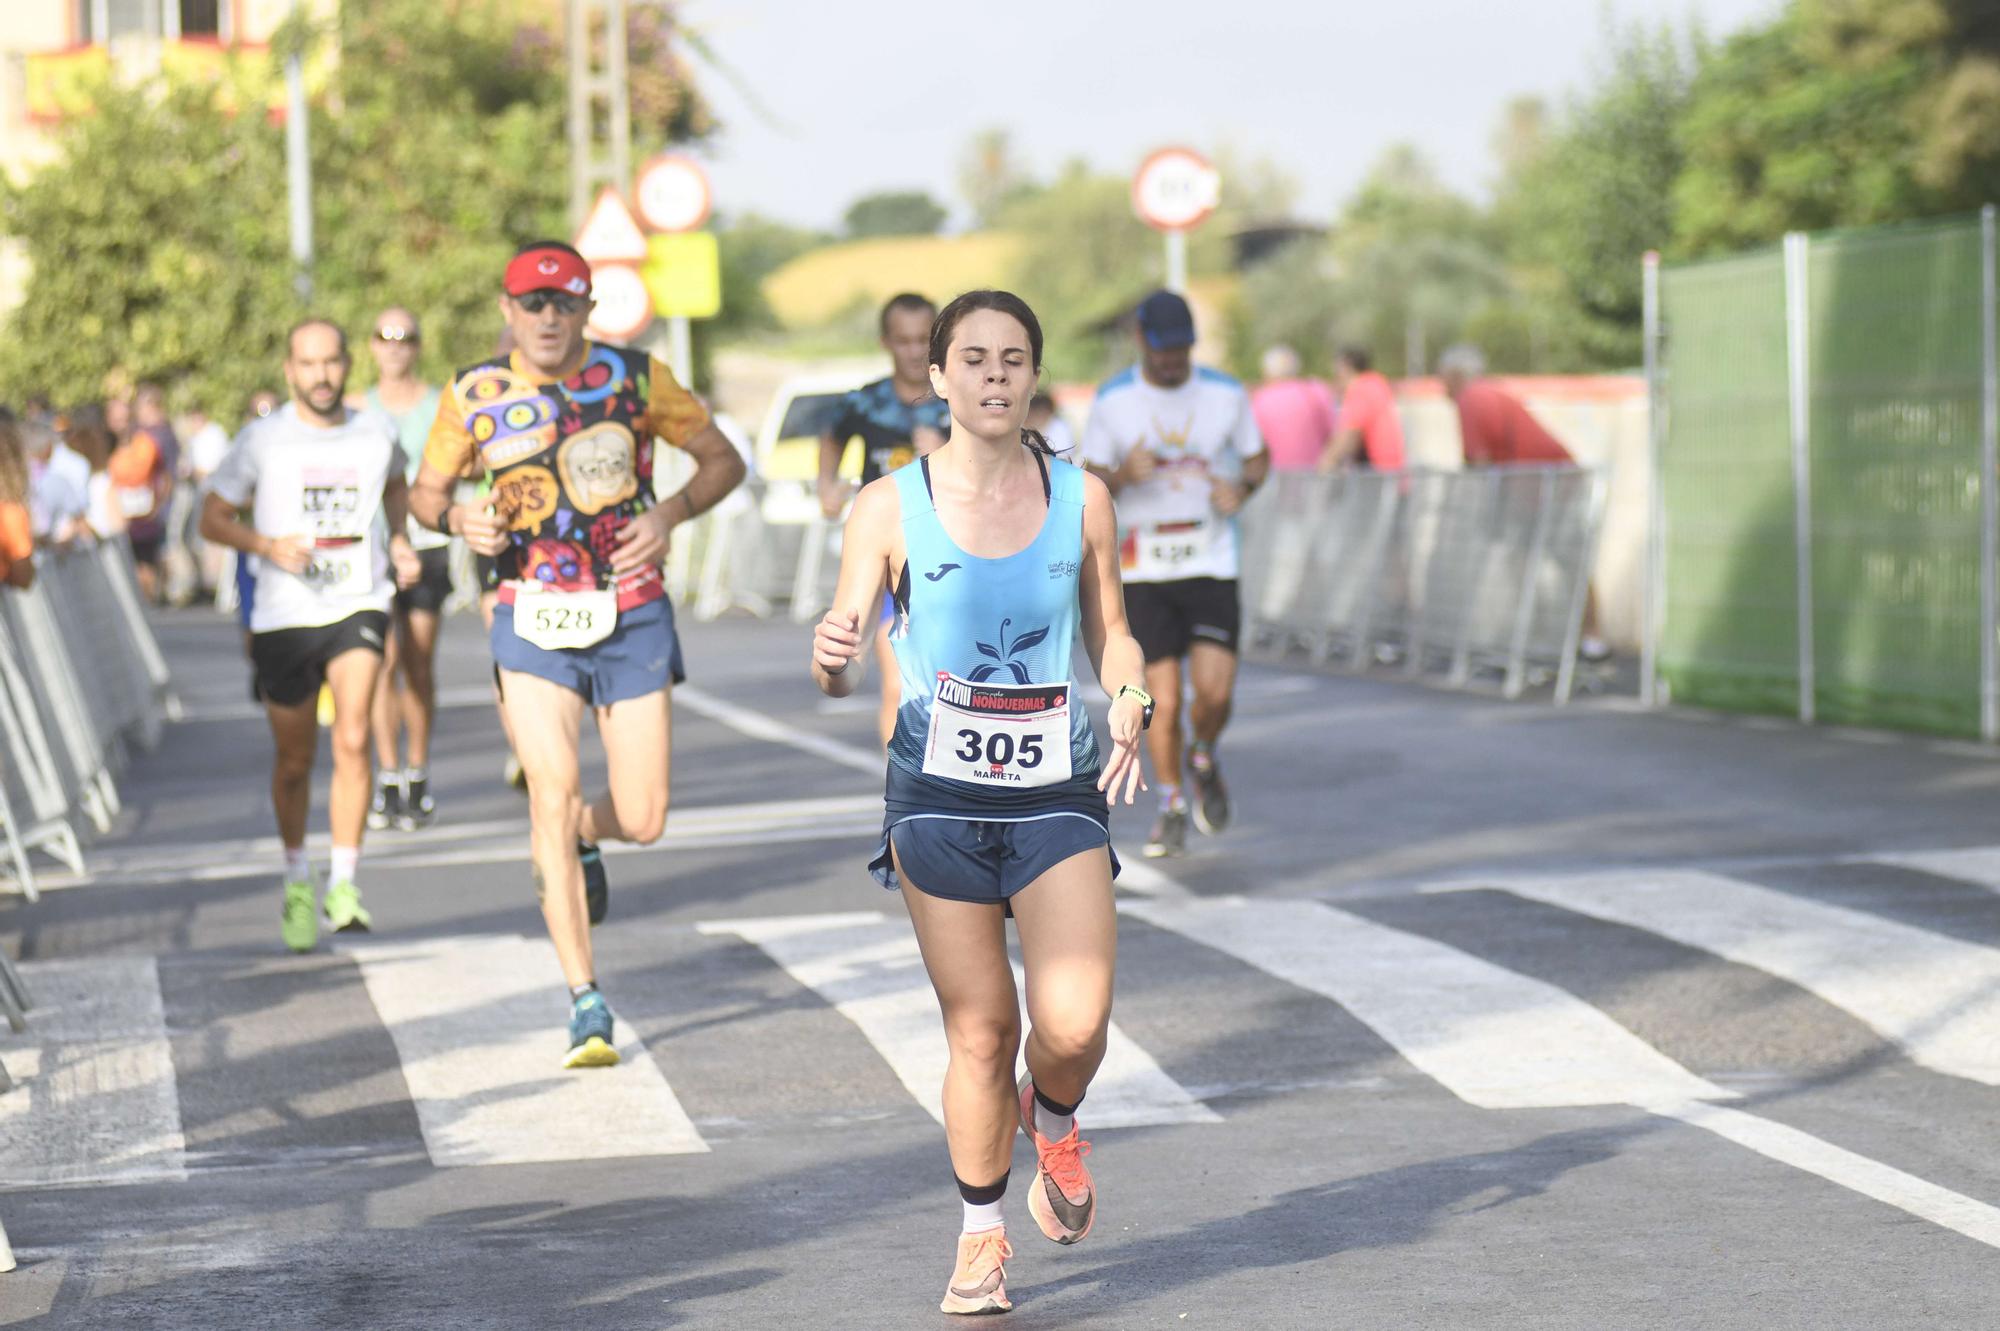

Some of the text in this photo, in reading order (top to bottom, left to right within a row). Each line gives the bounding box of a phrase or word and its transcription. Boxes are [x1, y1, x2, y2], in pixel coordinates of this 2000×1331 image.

[536, 608, 593, 630] 528
[972, 694, 1046, 711] NONDUERMAS
[955, 729, 1043, 768] 305
[973, 769, 1021, 781] MARIETA
